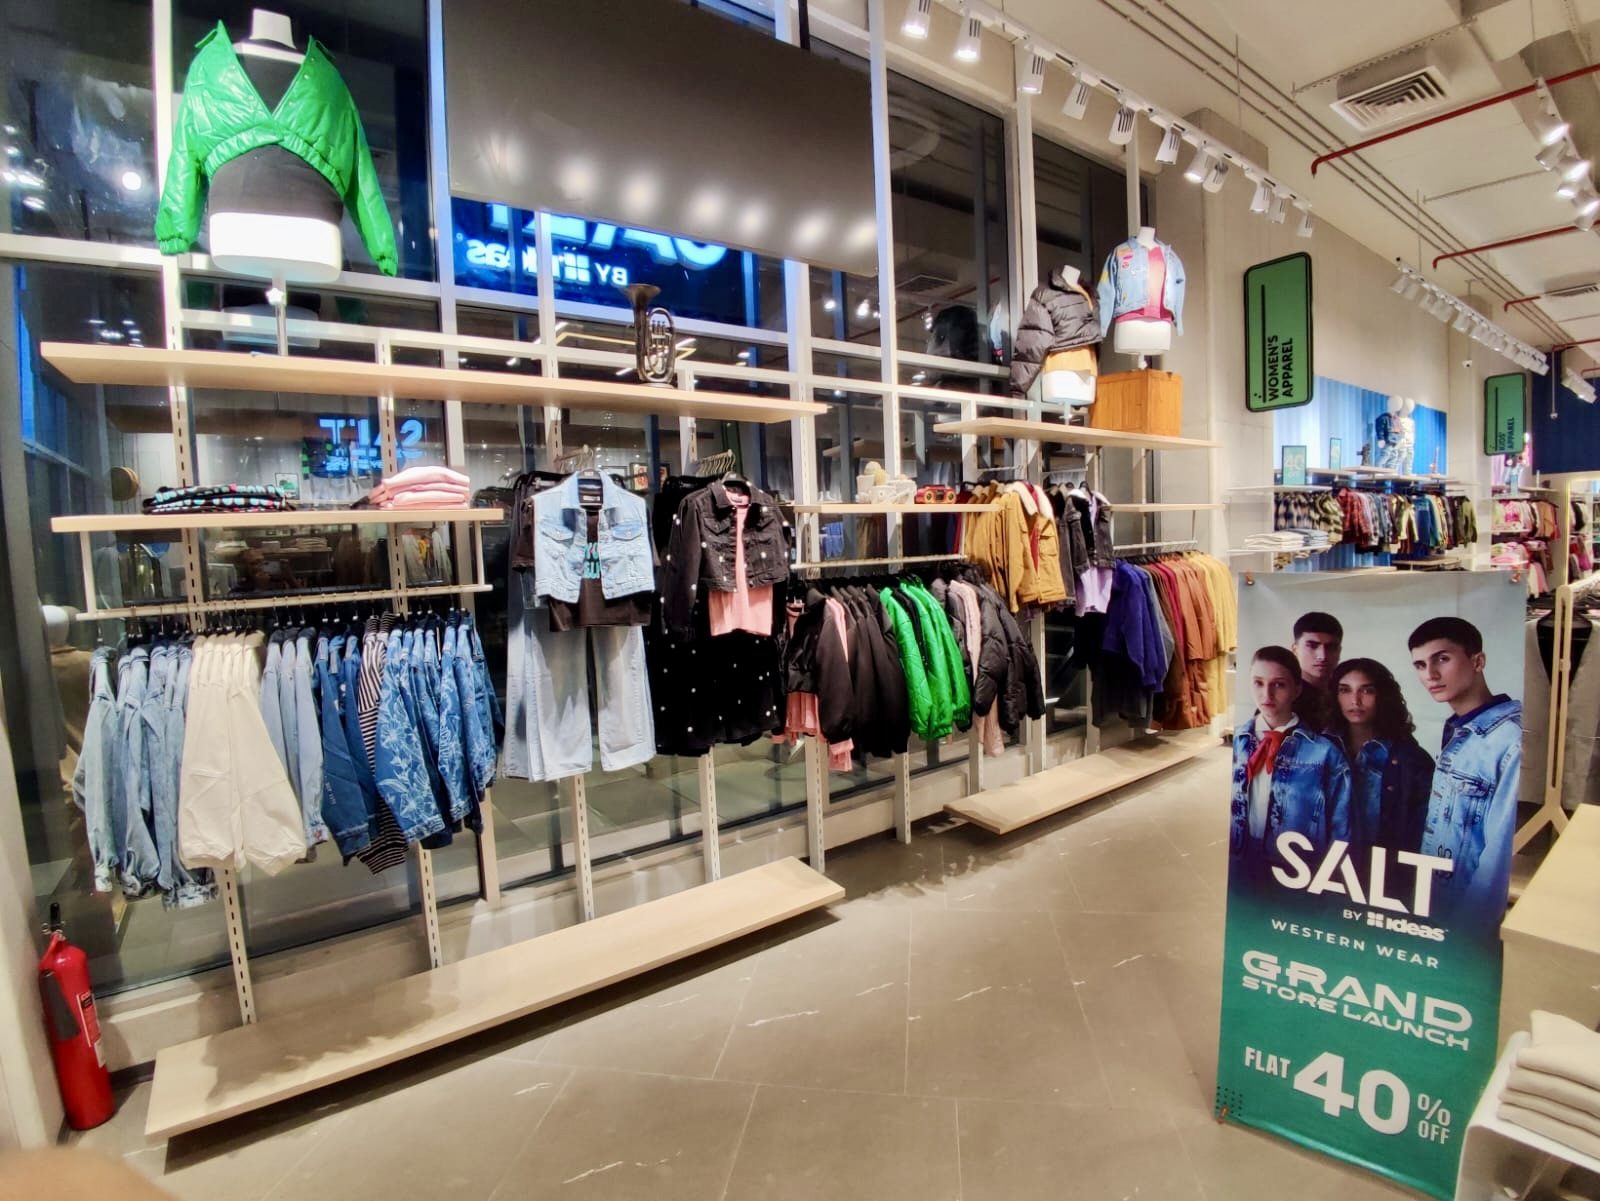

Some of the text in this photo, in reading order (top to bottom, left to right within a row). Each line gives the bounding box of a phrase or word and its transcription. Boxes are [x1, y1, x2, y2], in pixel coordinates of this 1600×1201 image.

[1268, 334, 1279, 402] WOMEN'S
[1282, 338, 1293, 398] APPAREL
[1271, 831, 1454, 918] SALT
[1271, 919, 1439, 969] WESTERN WEAR
[1343, 909, 1362, 921] BY
[1242, 950, 1473, 1032] GRAND
[1242, 975, 1469, 1051] STORE LAUNCH
[1245, 1046, 1291, 1078] FLAT
[1293, 1051, 1411, 1135] 40
[1418, 1120, 1450, 1144] OFF
